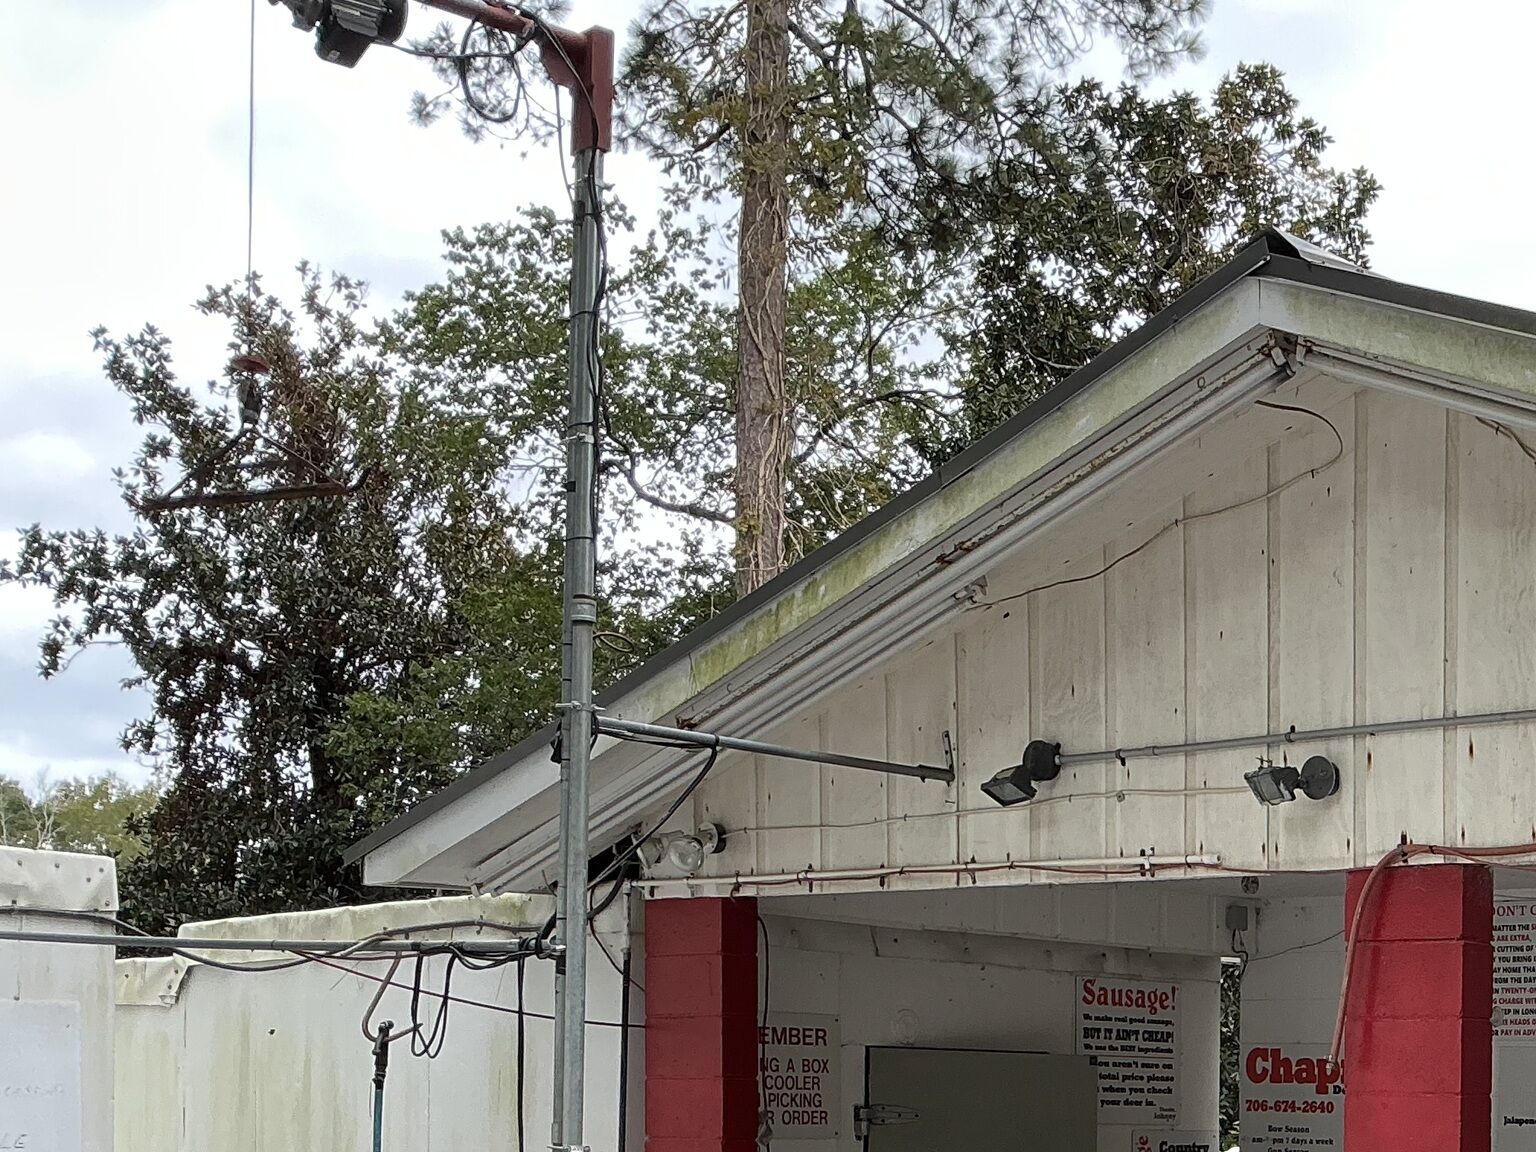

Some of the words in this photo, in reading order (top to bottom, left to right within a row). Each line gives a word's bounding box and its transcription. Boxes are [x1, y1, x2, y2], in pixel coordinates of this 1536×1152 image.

[1517, 923, 1530, 931] THE
[1497, 945, 1525, 953] CUTTING
[1498, 956, 1511, 964] YOU
[1512, 955, 1533, 963] BRING
[1523, 976, 1536, 984] DAY
[1082, 978, 1176, 1015] Sausage!
[758, 1027, 827, 1046] EMBER
[1083, 1027, 1101, 1040] BUT
[1104, 1028, 1113, 1040] IT
[802, 1058, 829, 1073] BOX
[1246, 1047, 1344, 1094] Chap
[764, 1075, 821, 1091] COOLER
[1099, 1072, 1119, 1081] total
[1122, 1073, 1144, 1083] price
[1147, 1074, 1174, 1084] please
[1102, 1085, 1126, 1094] when
[1128, 1087, 1144, 1095] you
[1147, 1086, 1173, 1094] check
[768, 1093, 822, 1108] PICKING
[1100, 1099, 1121, 1107] your
[1123, 1098, 1142, 1106] deer
[1245, 1100, 1334, 1113] 706-674-2640
[782, 1110, 828, 1125] ORDER
